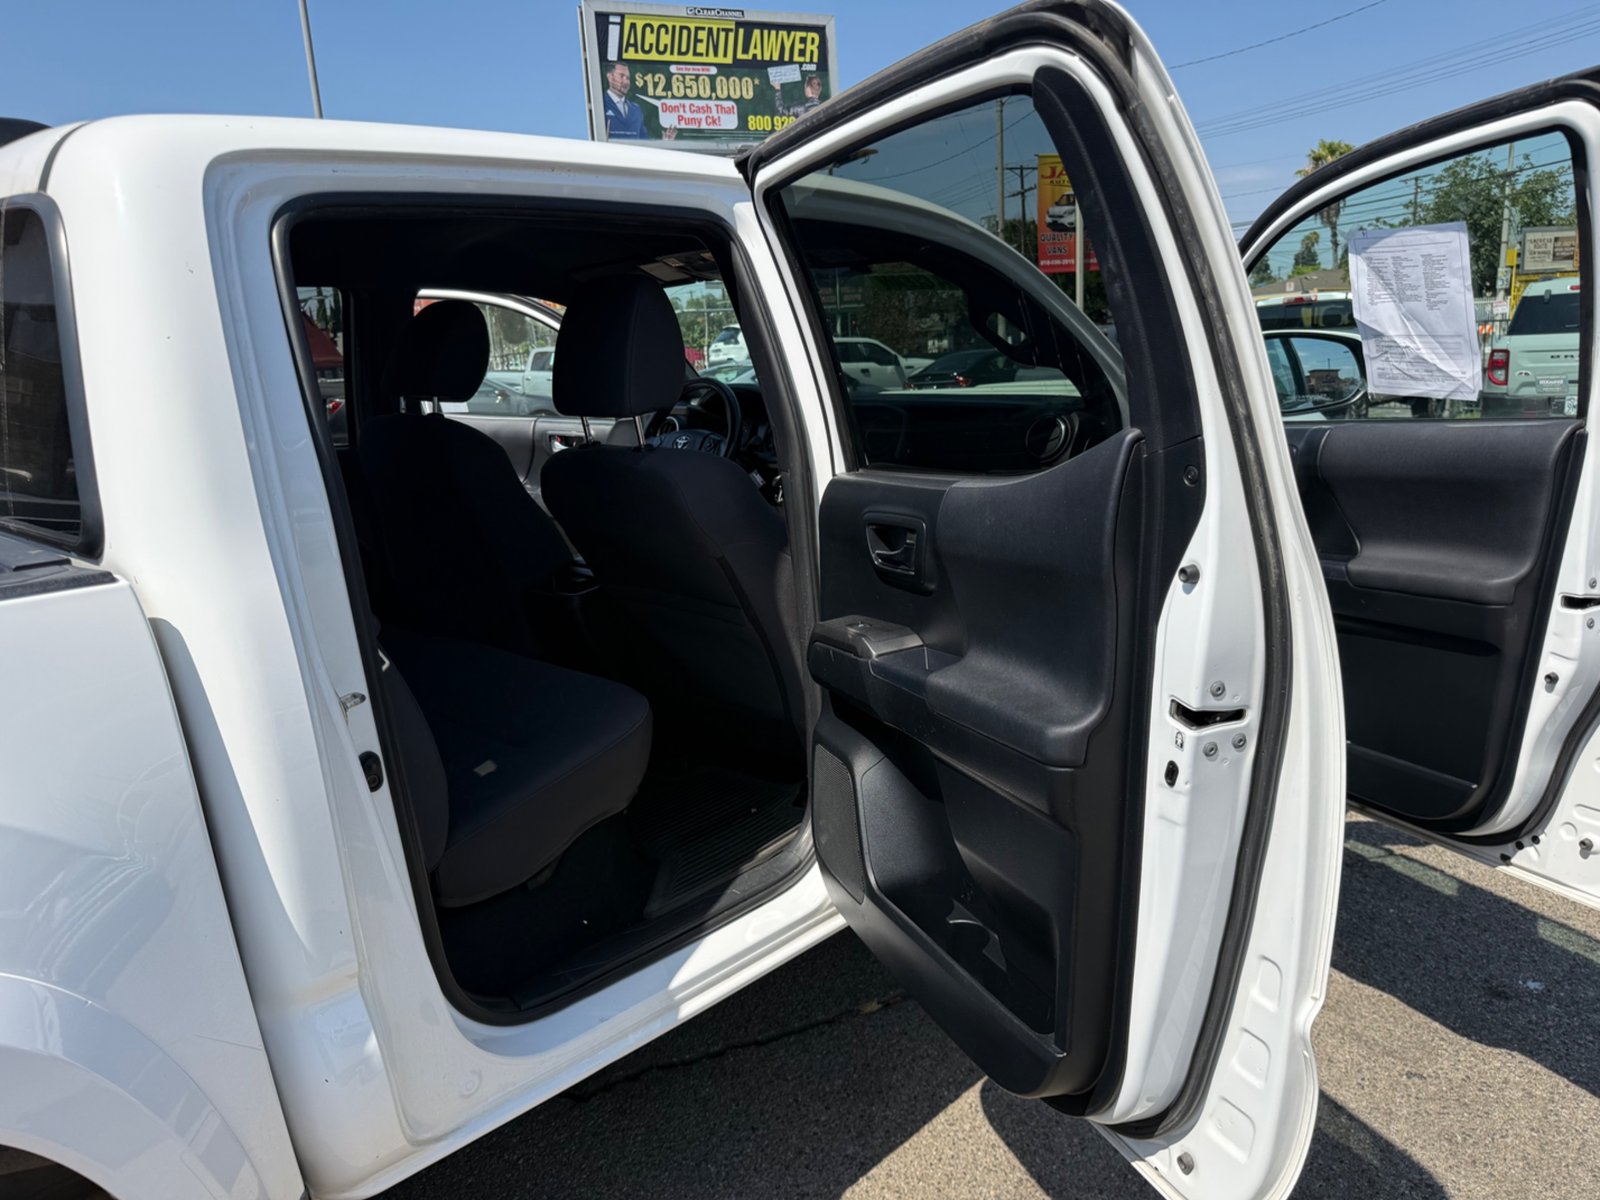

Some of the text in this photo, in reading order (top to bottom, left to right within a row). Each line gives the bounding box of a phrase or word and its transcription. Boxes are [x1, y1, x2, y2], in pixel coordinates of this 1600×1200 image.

[624, 22, 734, 58] ACCIDENT
[736, 28, 820, 63] LAWYER
[661, 102, 735, 115] Don't Cash That
[678, 115, 721, 128] Puny Ck!
[748, 115, 771, 130] 800
[1040, 232, 1073, 242] QUALITY
[1047, 246, 1067, 255] VANS
